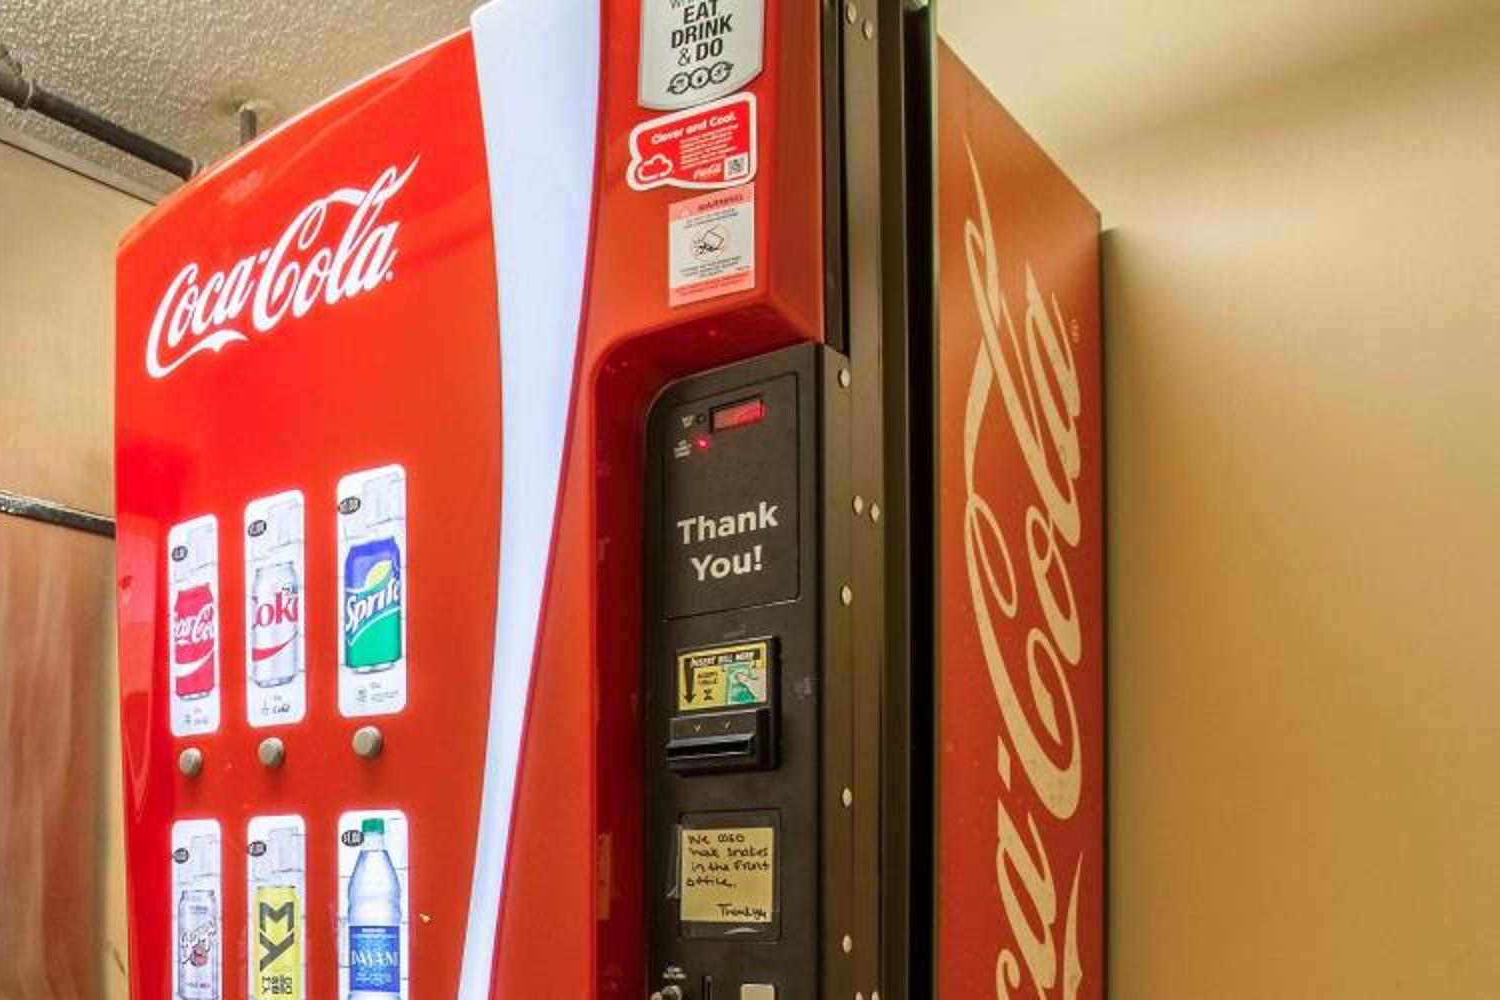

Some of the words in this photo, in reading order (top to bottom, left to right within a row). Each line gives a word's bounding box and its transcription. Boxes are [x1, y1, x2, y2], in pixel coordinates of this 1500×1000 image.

[683, 0, 717, 24] EAT
[671, 13, 733, 48] DRINK
[678, 47, 690, 66] &
[696, 37, 723, 62] DO
[676, 501, 779, 545] Thank
[691, 545, 764, 581] You!
